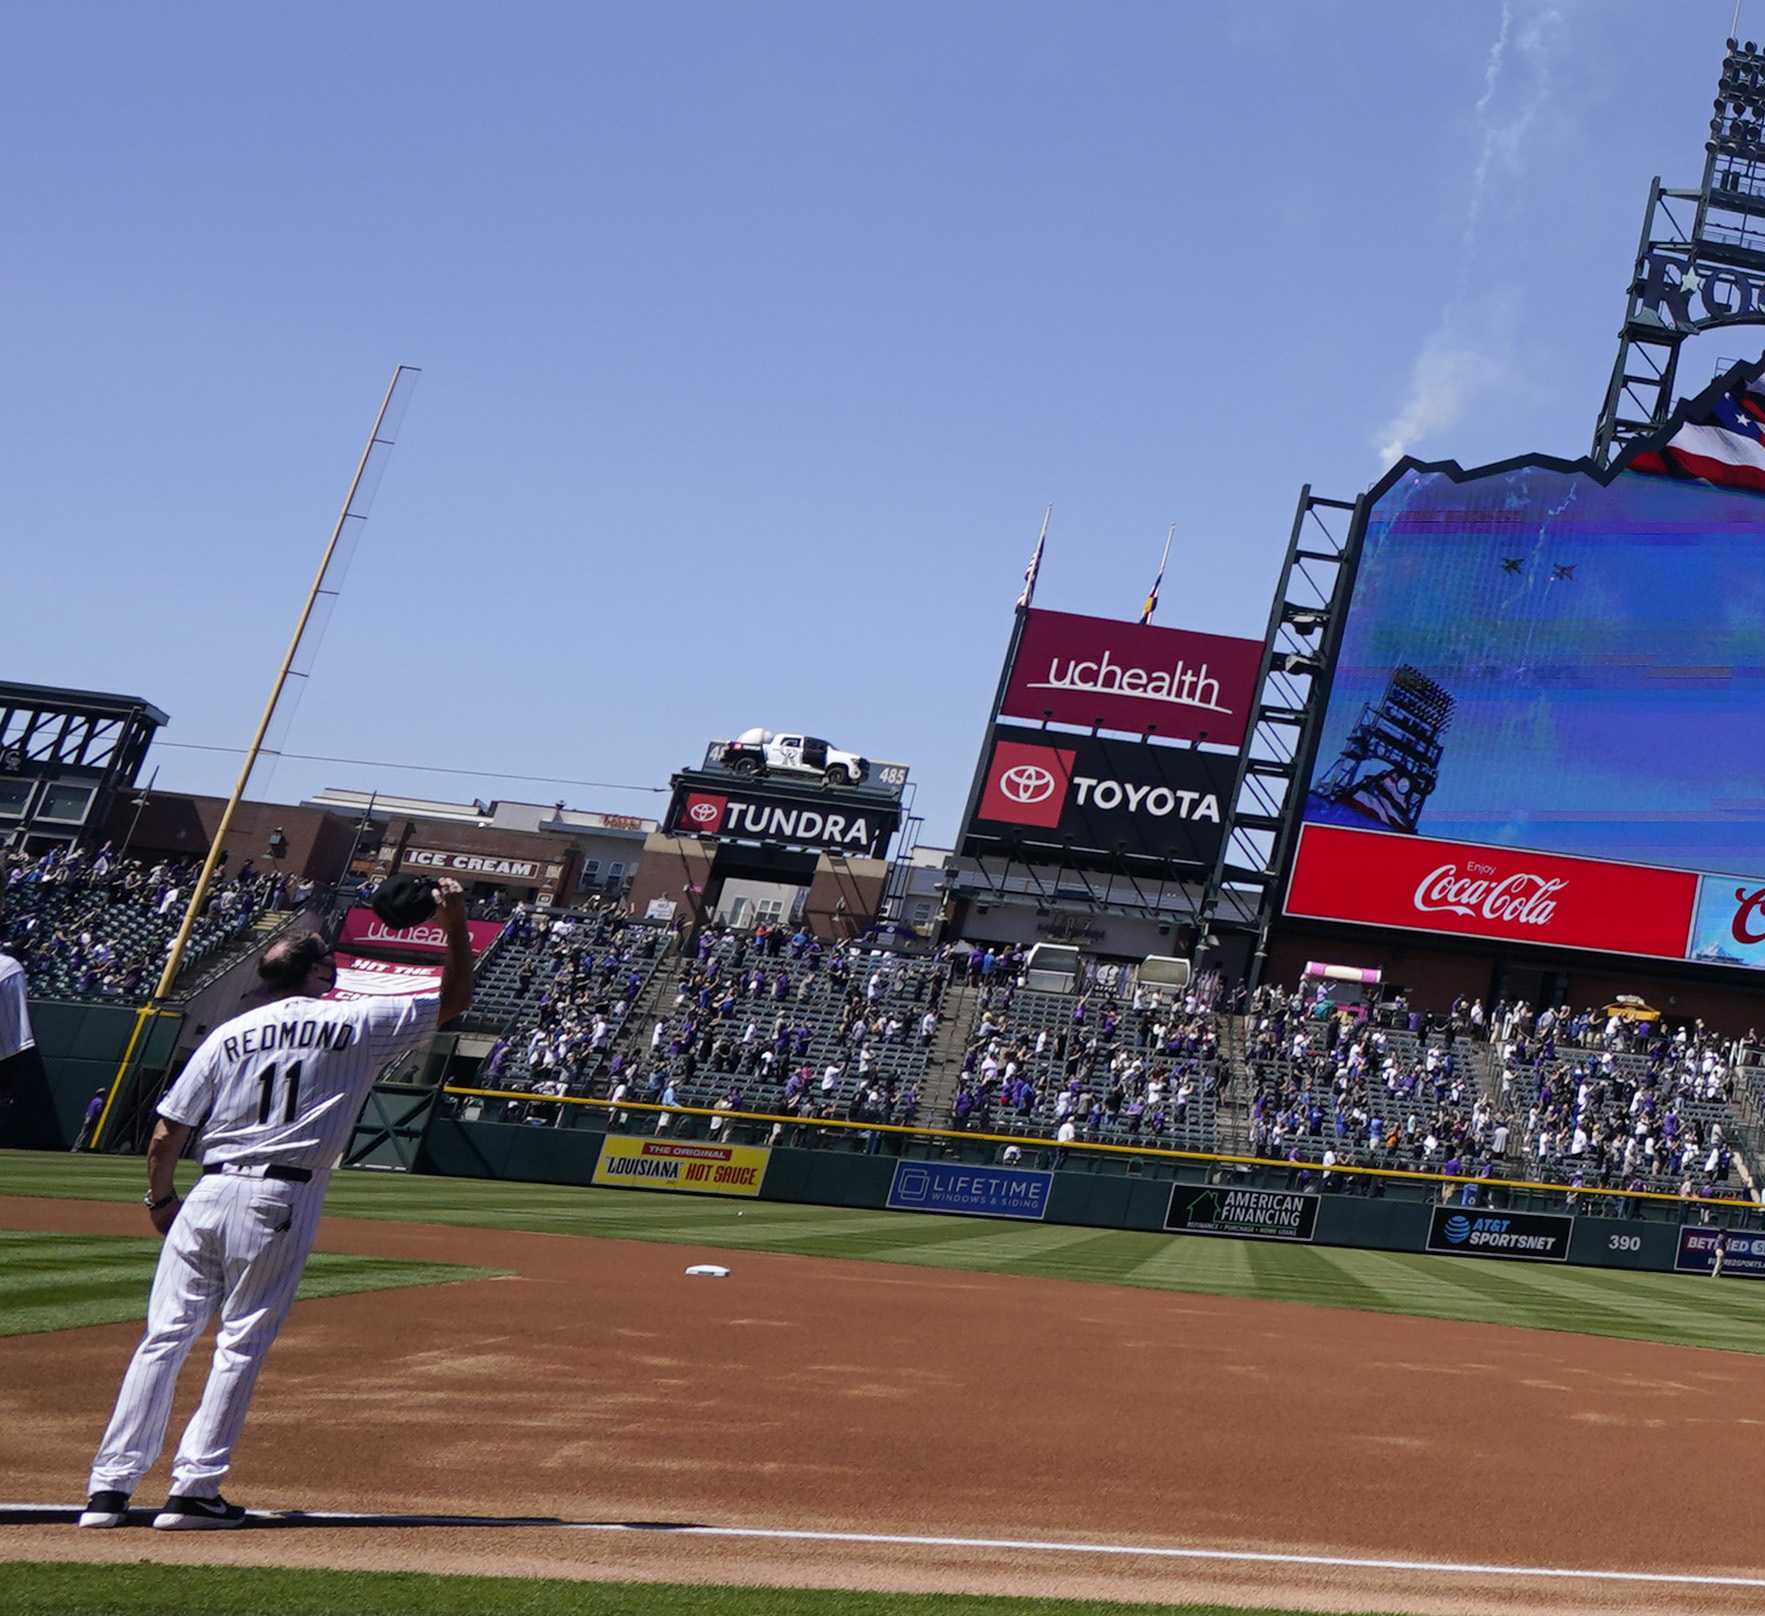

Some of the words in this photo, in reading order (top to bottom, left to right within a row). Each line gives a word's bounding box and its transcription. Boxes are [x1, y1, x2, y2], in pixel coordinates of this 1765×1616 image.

[1049, 651, 1220, 706] uchealth
[879, 767, 905, 784] 485
[1073, 777, 1220, 823] TOYOTA
[727, 802, 868, 845] TUNDRA
[408, 851, 446, 866] ICE
[452, 856, 532, 875] CREAM
[1467, 861, 1496, 875] Enjoy
[1413, 864, 1569, 925] Coca-Cola
[367, 921, 474, 945] uchea
[351, 959, 392, 972] HIT
[394, 965, 436, 976] THE
[224, 1020, 353, 1062] REDMOND
[257, 1060, 302, 1124] 11
[649, 1145, 671, 1155] THE
[673, 1147, 726, 1159] ORIGINAL
[685, 1163, 714, 1181] HOT
[714, 1165, 758, 1185] SAUCE
[933, 1175, 1042, 1199] LIFETIME
[931, 1192, 987, 1204] WINDOWS
[990, 1197, 997, 1205] &
[1000, 1199, 1039, 1209] SIDING
[1224, 1191, 1304, 1212] AMERICAN
[1220, 1207, 1300, 1226] FINANCING
[1473, 1218, 1511, 1233] AT&T
[1469, 1232, 1556, 1250] SPORTSNET
[1608, 1235, 1641, 1251] 390
